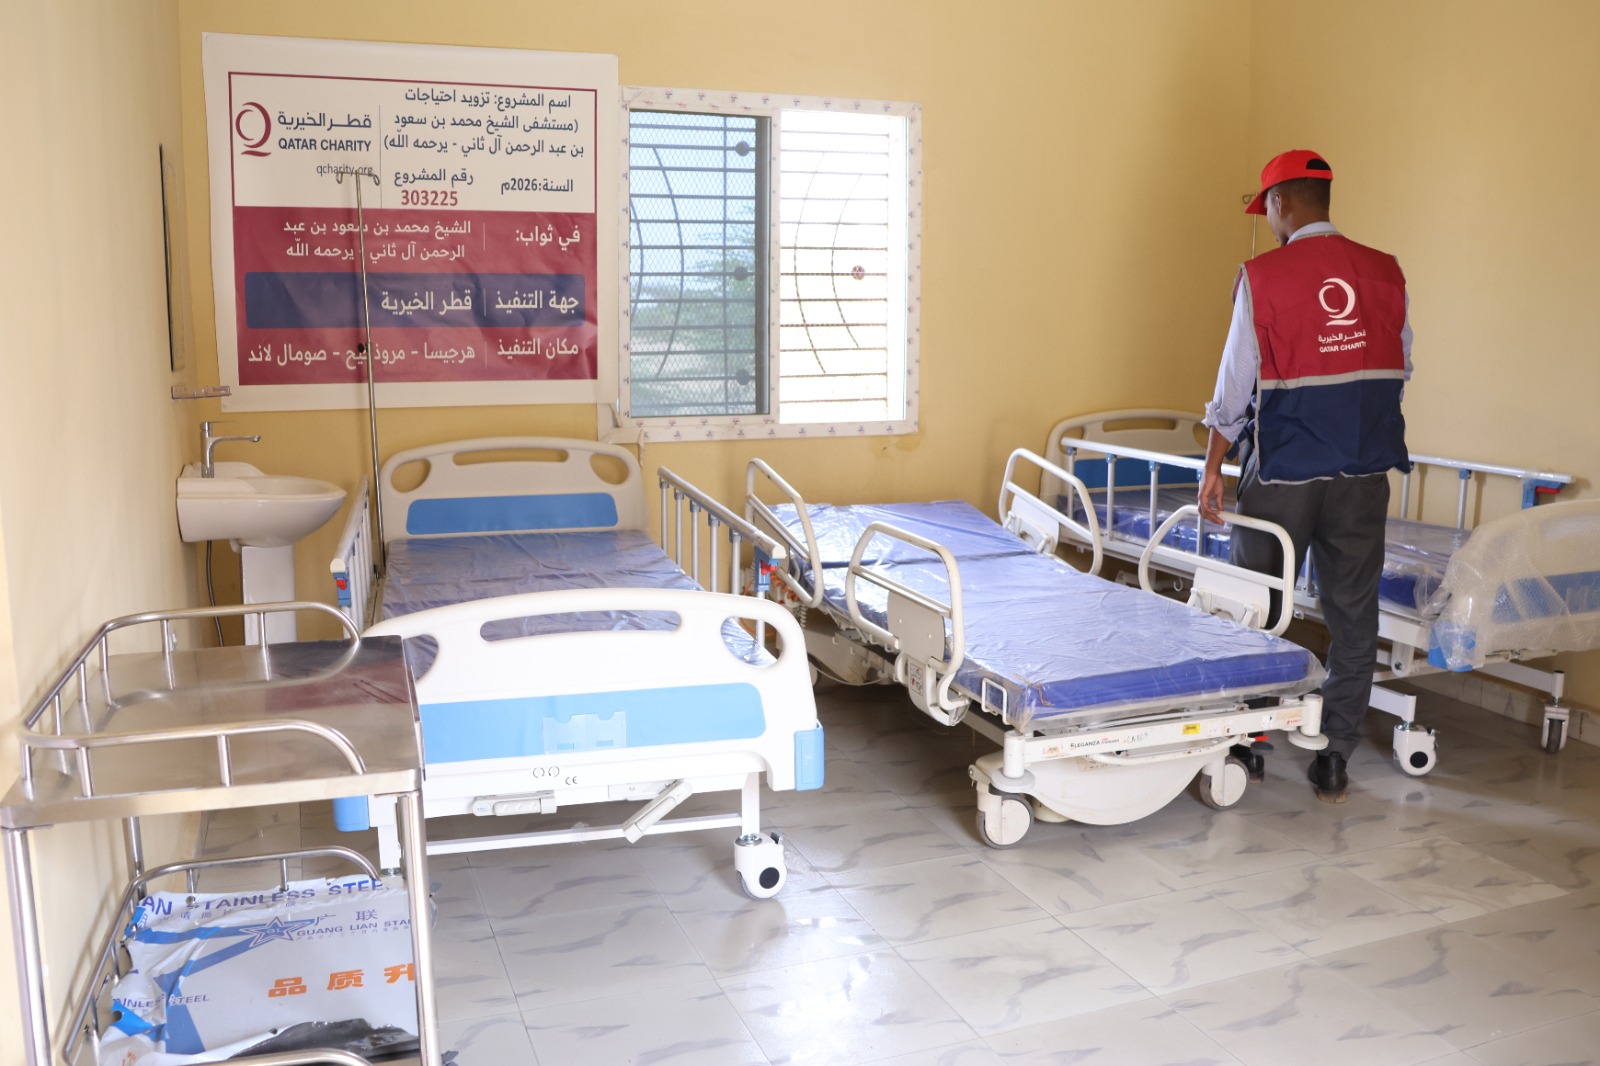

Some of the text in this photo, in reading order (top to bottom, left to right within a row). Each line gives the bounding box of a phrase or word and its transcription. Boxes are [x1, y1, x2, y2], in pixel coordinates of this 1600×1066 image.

[405, 87, 571, 114] اسم المشروع: تزويد احتياجات
[278, 111, 372, 131] قطر الخيرية
[394, 114, 579, 134] (مستشفى الشيخ محمد بن سعود
[278, 138, 372, 152] QATAR CHARITY
[413, 138, 448, 153] يرحمه
[461, 136, 485, 157] ثاني
[489, 135, 502, 155] آل
[505, 139, 544, 156] الرحمن
[548, 143, 567, 154] عبد
[570, 144, 584, 157] بن
[316, 163, 373, 177] qcharityorg
[394, 168, 474, 188] رقم المشروع
[401, 190, 459, 206] 303225
[283, 222, 306, 234] عبد
[310, 222, 327, 235] بن
[373, 222, 389, 236] بن
[394, 222, 430, 234] محمد
[435, 220, 471, 239] الشيخ
[516, 224, 581, 251] في ثواب:
[314, 246, 354, 260] يرحمه
[369, 242, 397, 263] ثاني
[401, 241, 416, 260] آل
[420, 245, 465, 261] الرحمن
[381, 289, 473, 315] قطر الخيرية
[495, 289, 579, 314] جهة التنفيذ
[248, 343, 272, 362] لاند
[277, 343, 327, 366] صومال
[424, 342, 476, 364] هرجيسا
[497, 337, 579, 360] مكان التنفيذ
[328, 879, 389, 896] STEE
[297, 926, 343, 937] GUANG
[350, 922, 378, 931] LIAN
[384, 919, 411, 927] STA
